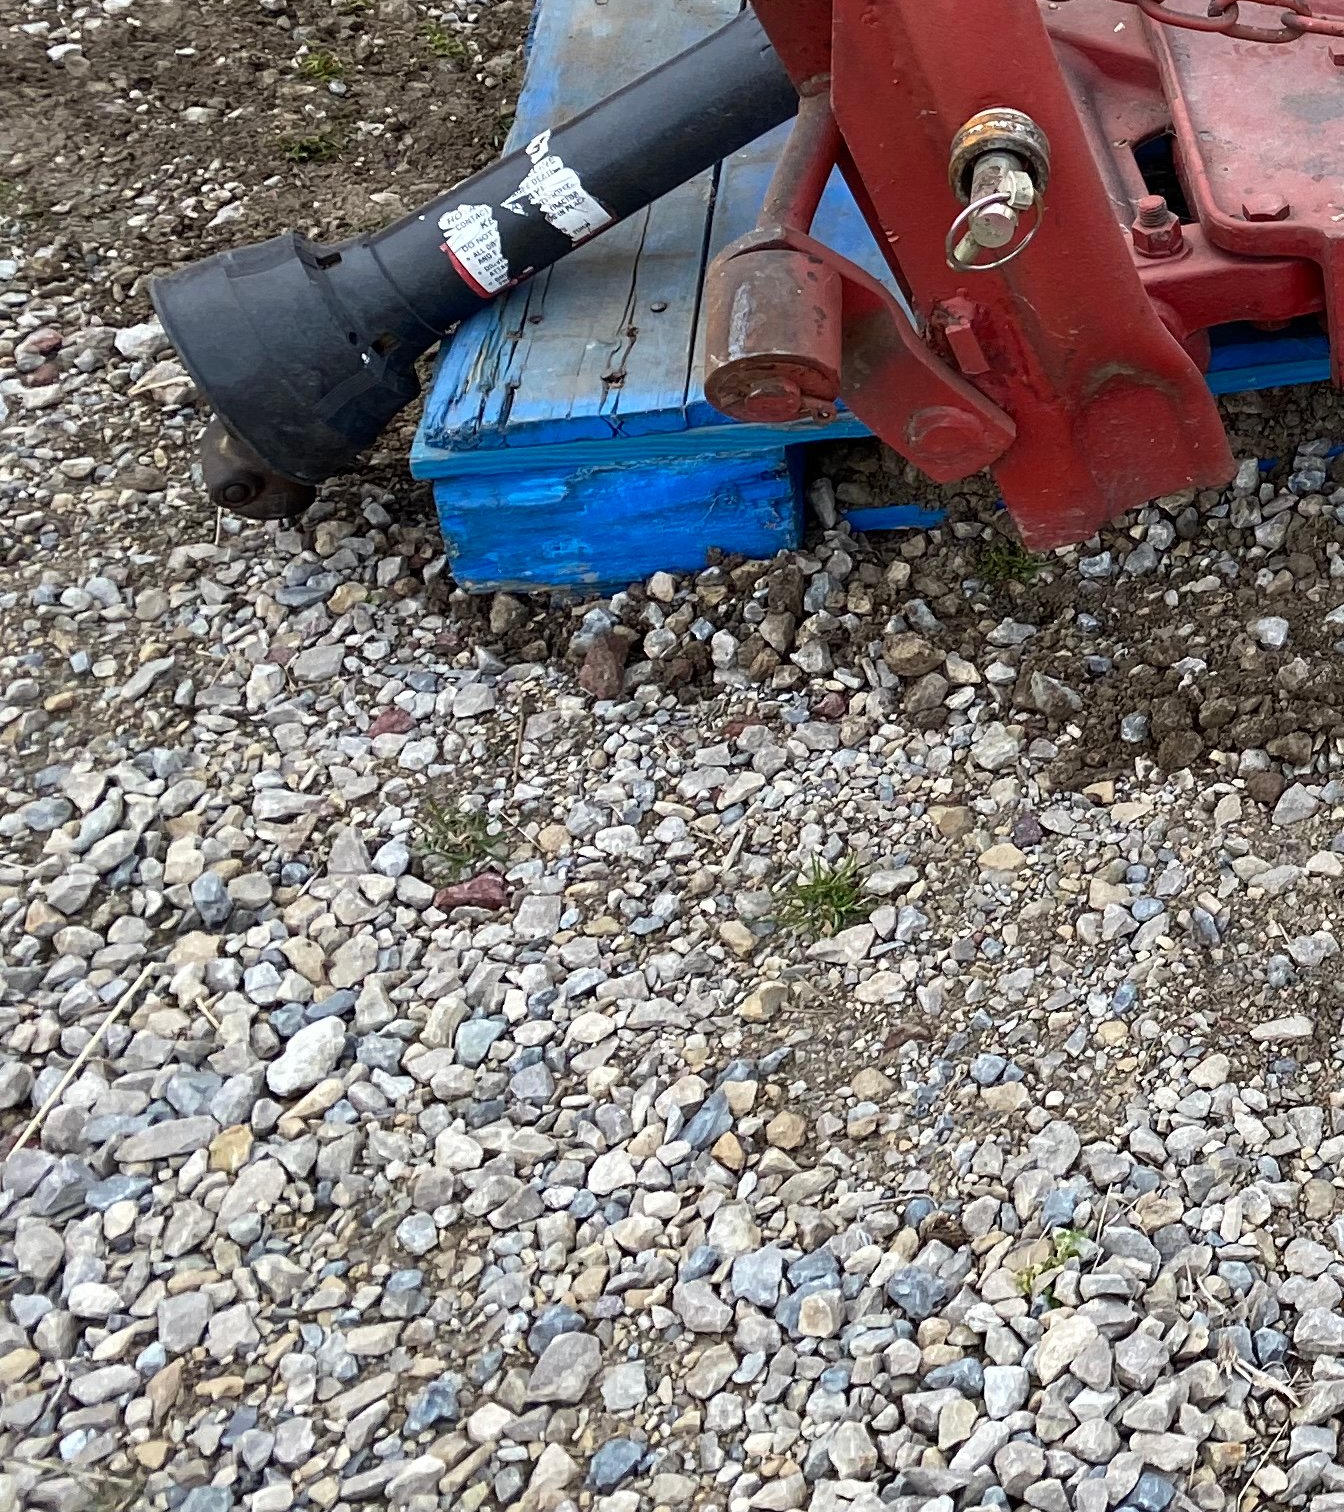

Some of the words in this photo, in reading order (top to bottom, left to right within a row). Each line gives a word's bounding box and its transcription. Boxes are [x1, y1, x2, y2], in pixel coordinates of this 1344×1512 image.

[461, 241, 475, 253] DO
[476, 229, 494, 244] NOT
[477, 254, 493, 265] AND
